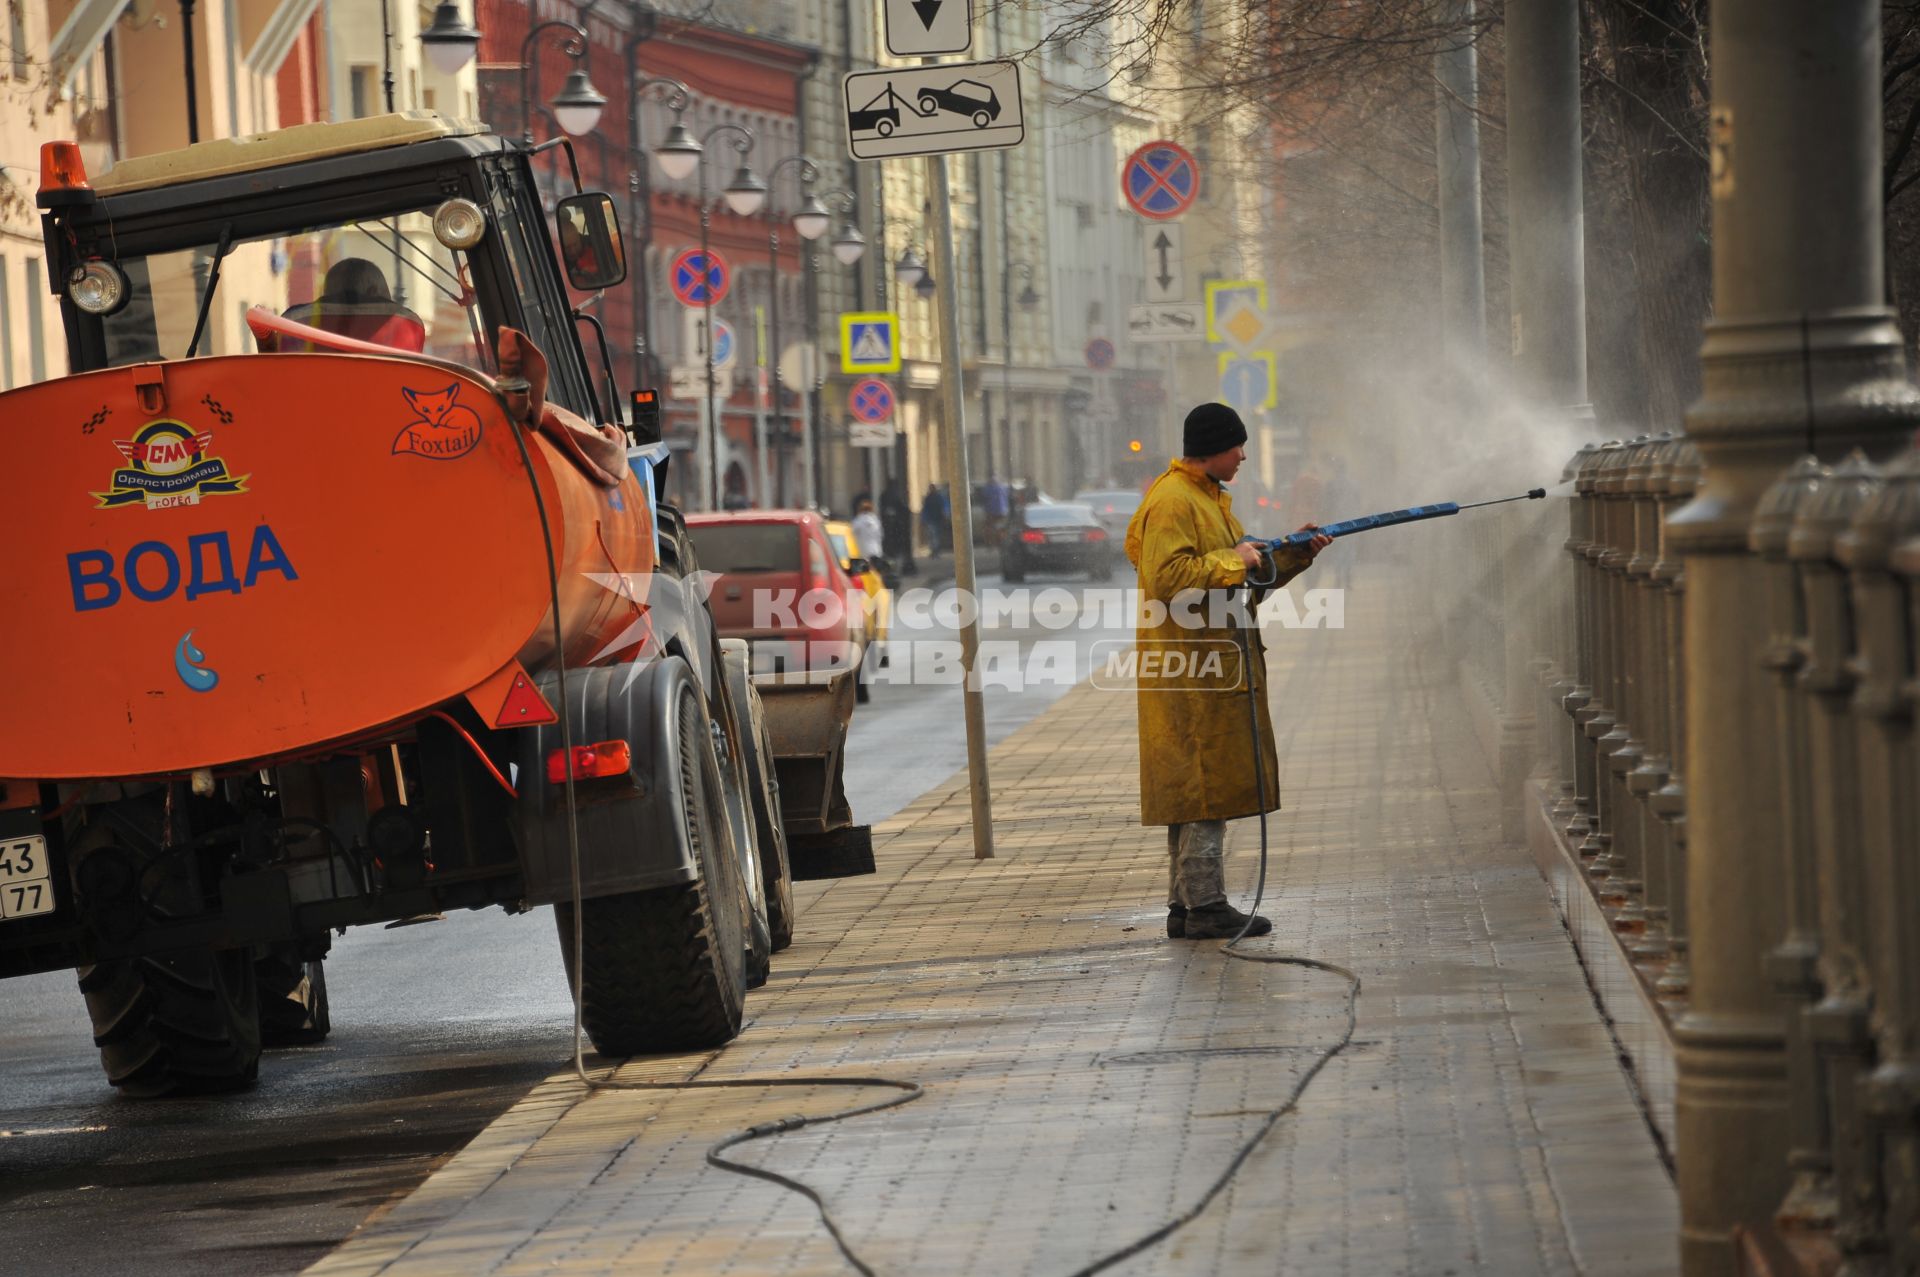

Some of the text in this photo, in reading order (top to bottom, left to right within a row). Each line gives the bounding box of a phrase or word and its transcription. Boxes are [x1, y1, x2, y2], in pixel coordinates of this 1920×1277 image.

[407, 426, 474, 453] Foxtail
[149, 443, 186, 464] СМ
[118, 465, 220, 488] Орелстроймаш
[66, 524, 299, 612] ВОДА
[10, 885, 42, 912] 77
